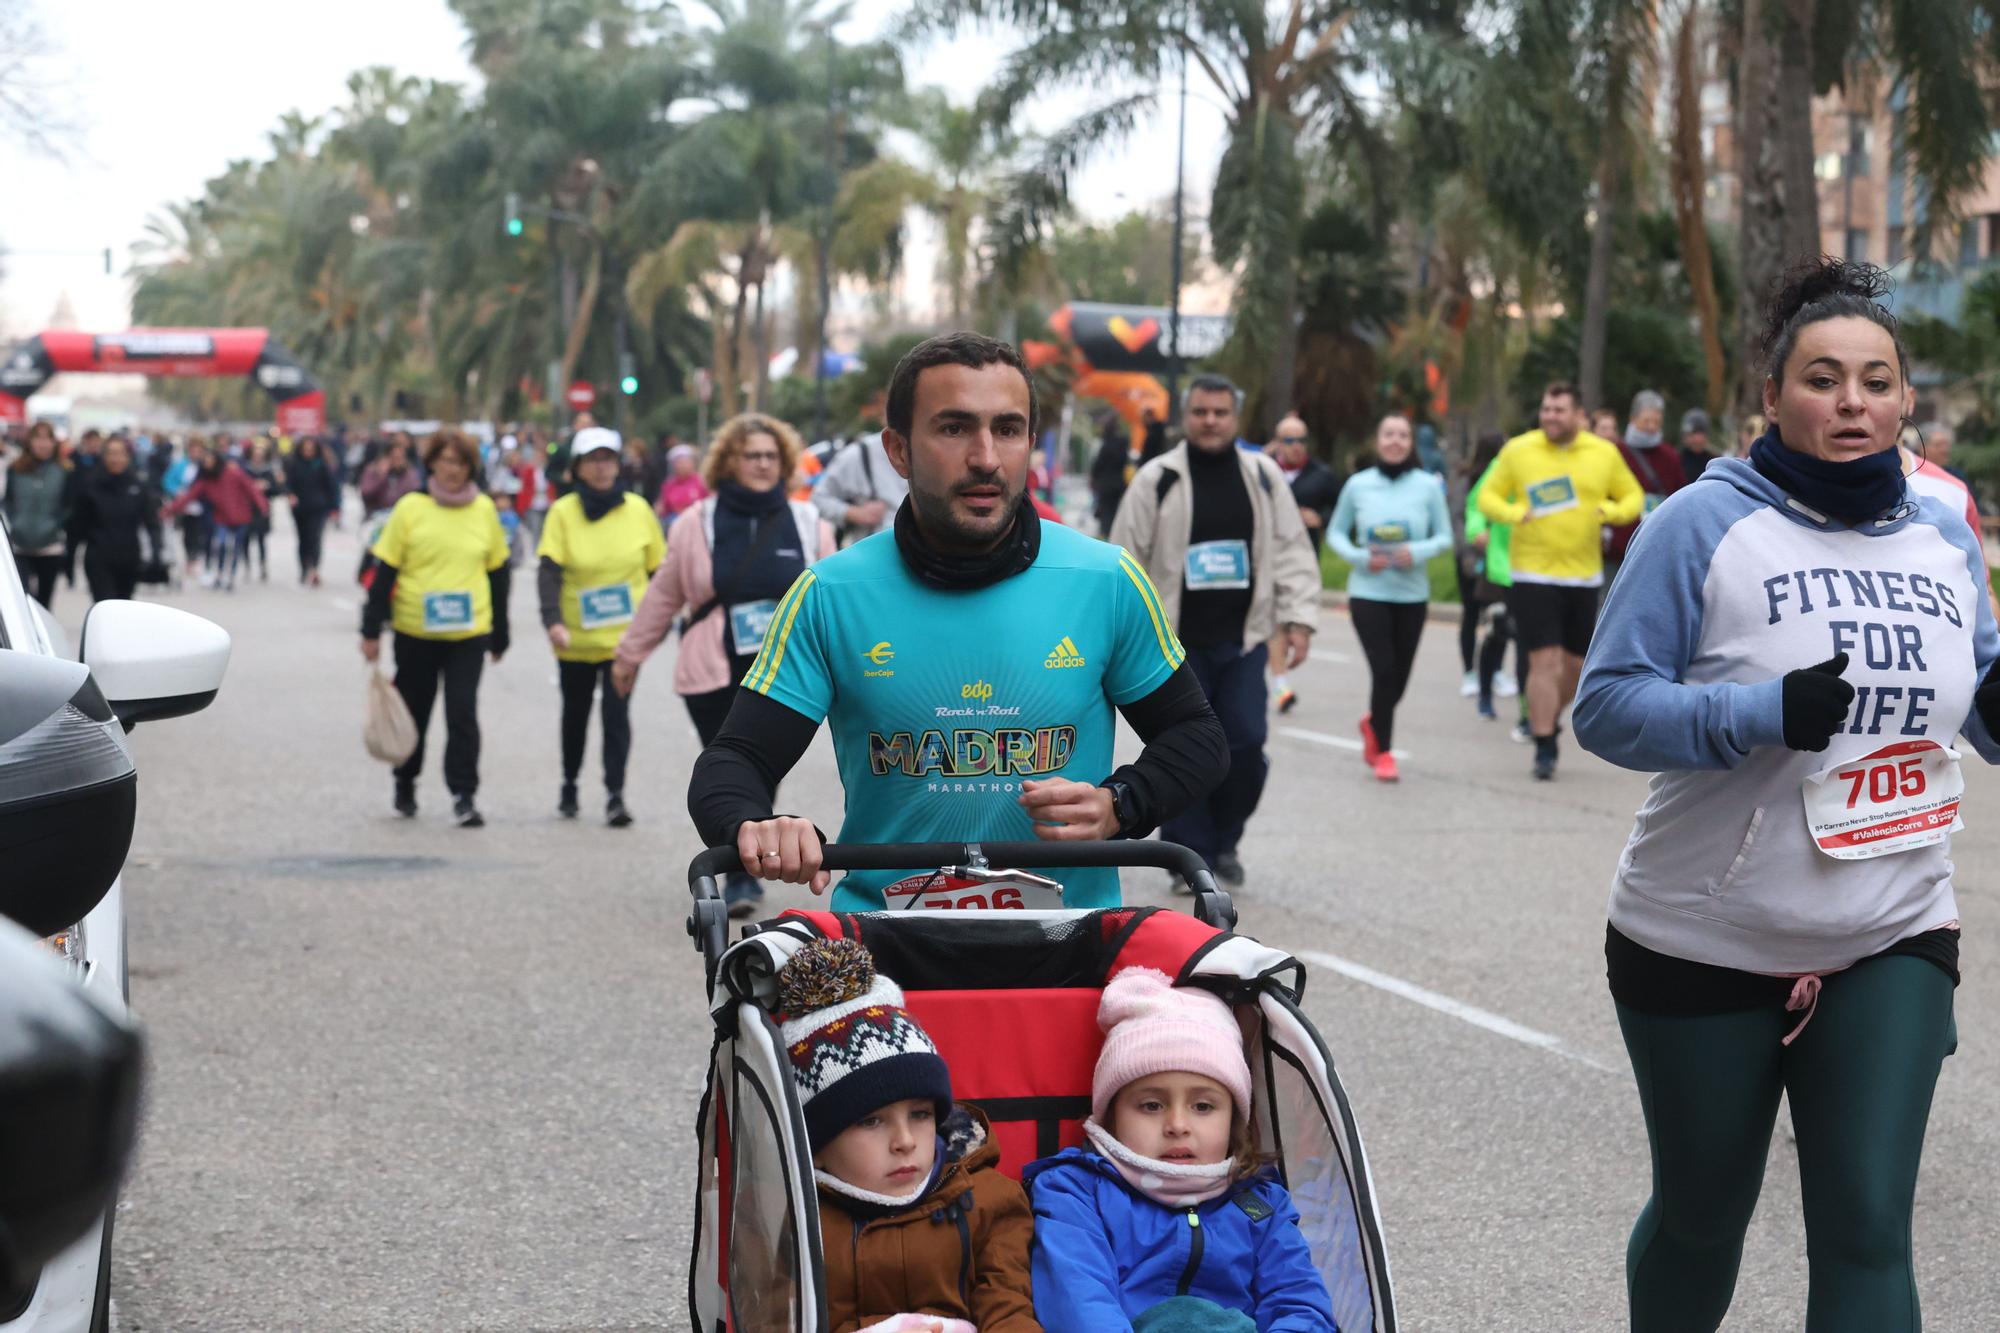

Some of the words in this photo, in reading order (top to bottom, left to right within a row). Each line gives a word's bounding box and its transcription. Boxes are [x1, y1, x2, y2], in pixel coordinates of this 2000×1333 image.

[1763, 568, 1963, 628] FITNESS
[1044, 656, 1085, 669] adidas
[1828, 620, 1928, 672] FOR
[961, 679, 993, 702] edp
[935, 707, 975, 717] Rock
[1835, 687, 1935, 736] IFE
[868, 724, 1077, 777] MADRID
[1839, 758, 1926, 809] 705
[1824, 821, 1850, 830] Carrera
[1850, 817, 1868, 825] Never
[1869, 814, 1884, 822] Stop
[1885, 809, 1908, 818] Running
[1852, 821, 1923, 840] #ValènciaCorre
